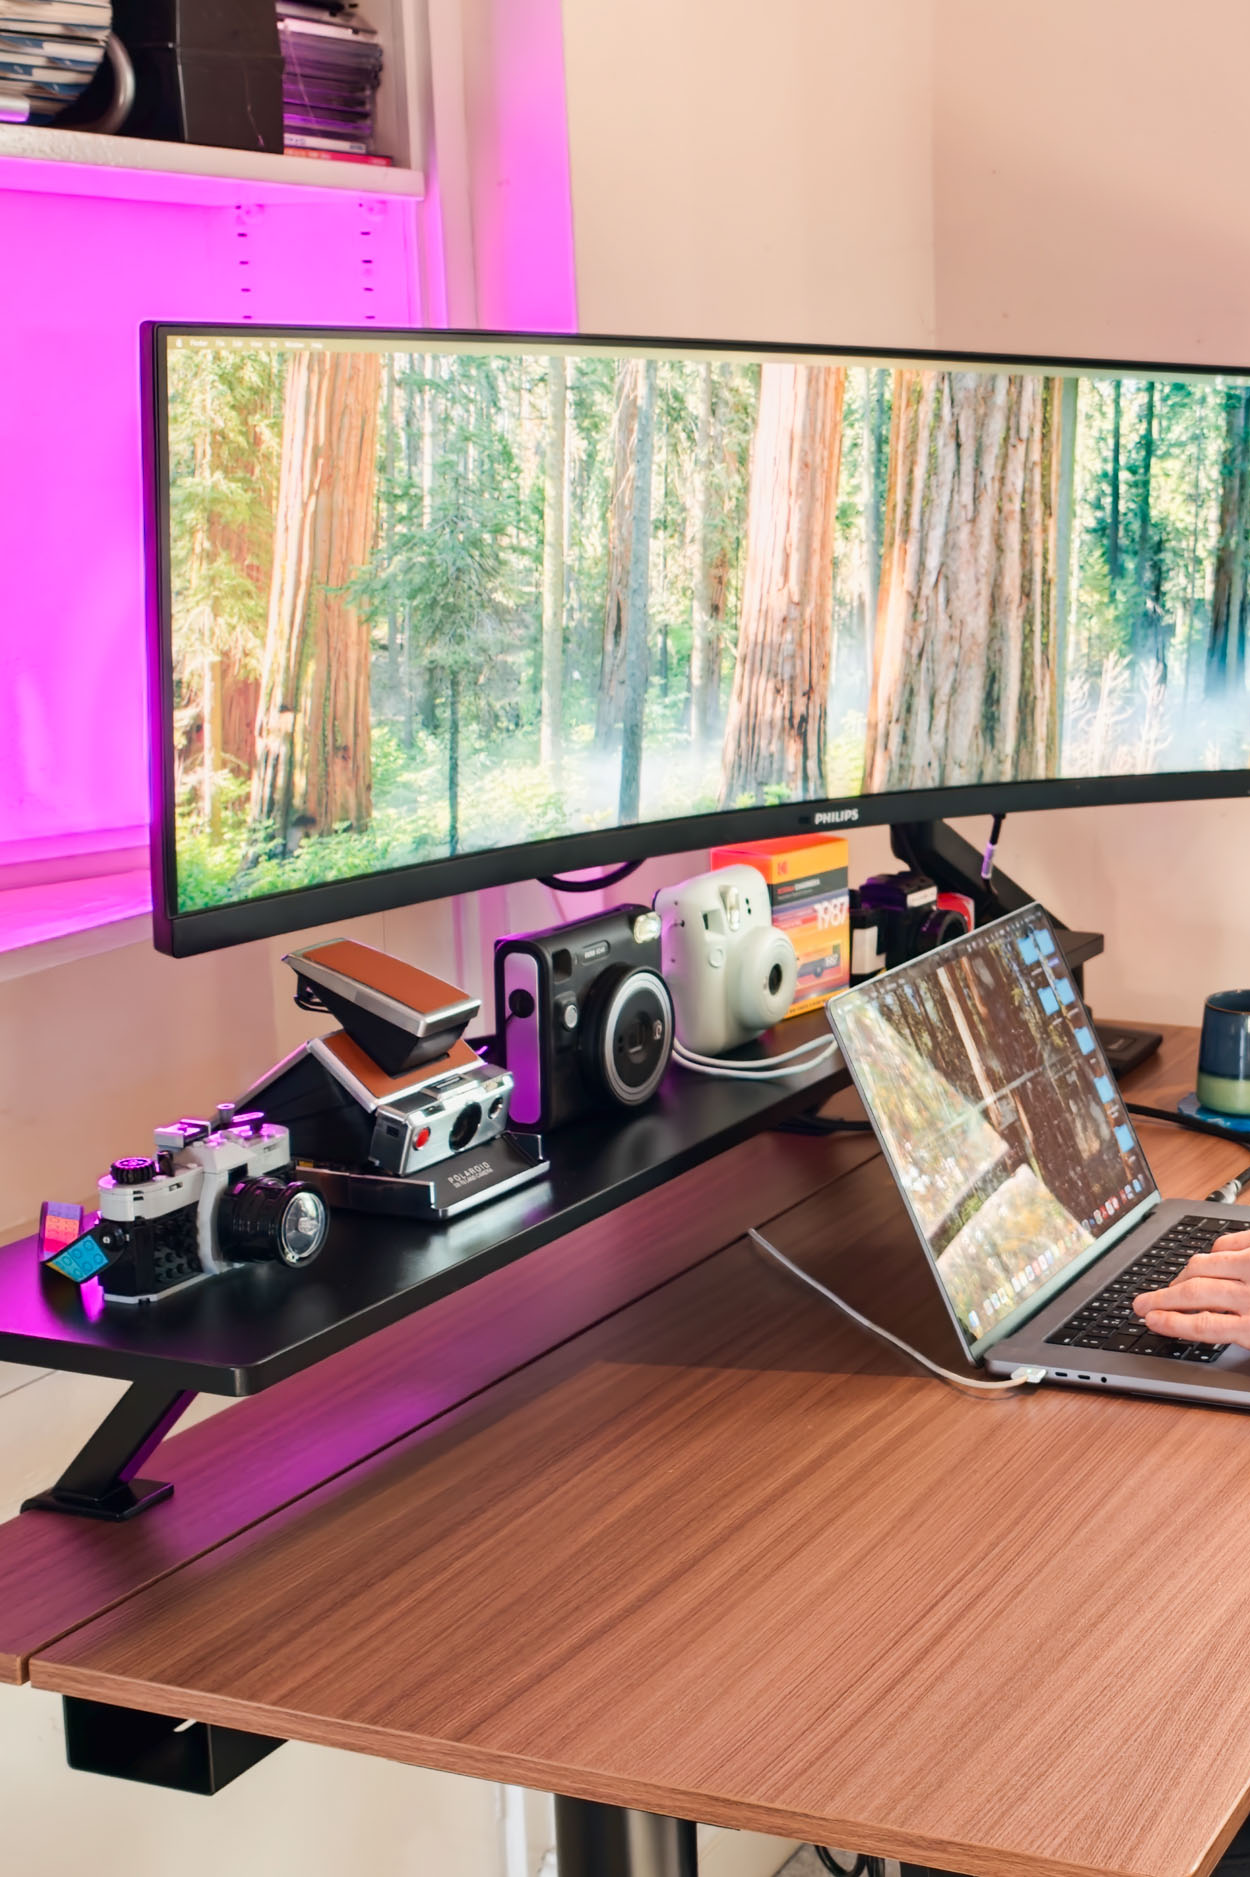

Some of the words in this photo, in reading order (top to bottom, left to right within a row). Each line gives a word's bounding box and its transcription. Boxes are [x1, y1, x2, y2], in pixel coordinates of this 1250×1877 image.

[814, 808, 859, 825] PHILIPS
[814, 896, 849, 929] 1987
[447, 1161, 490, 1184] POLAROID
